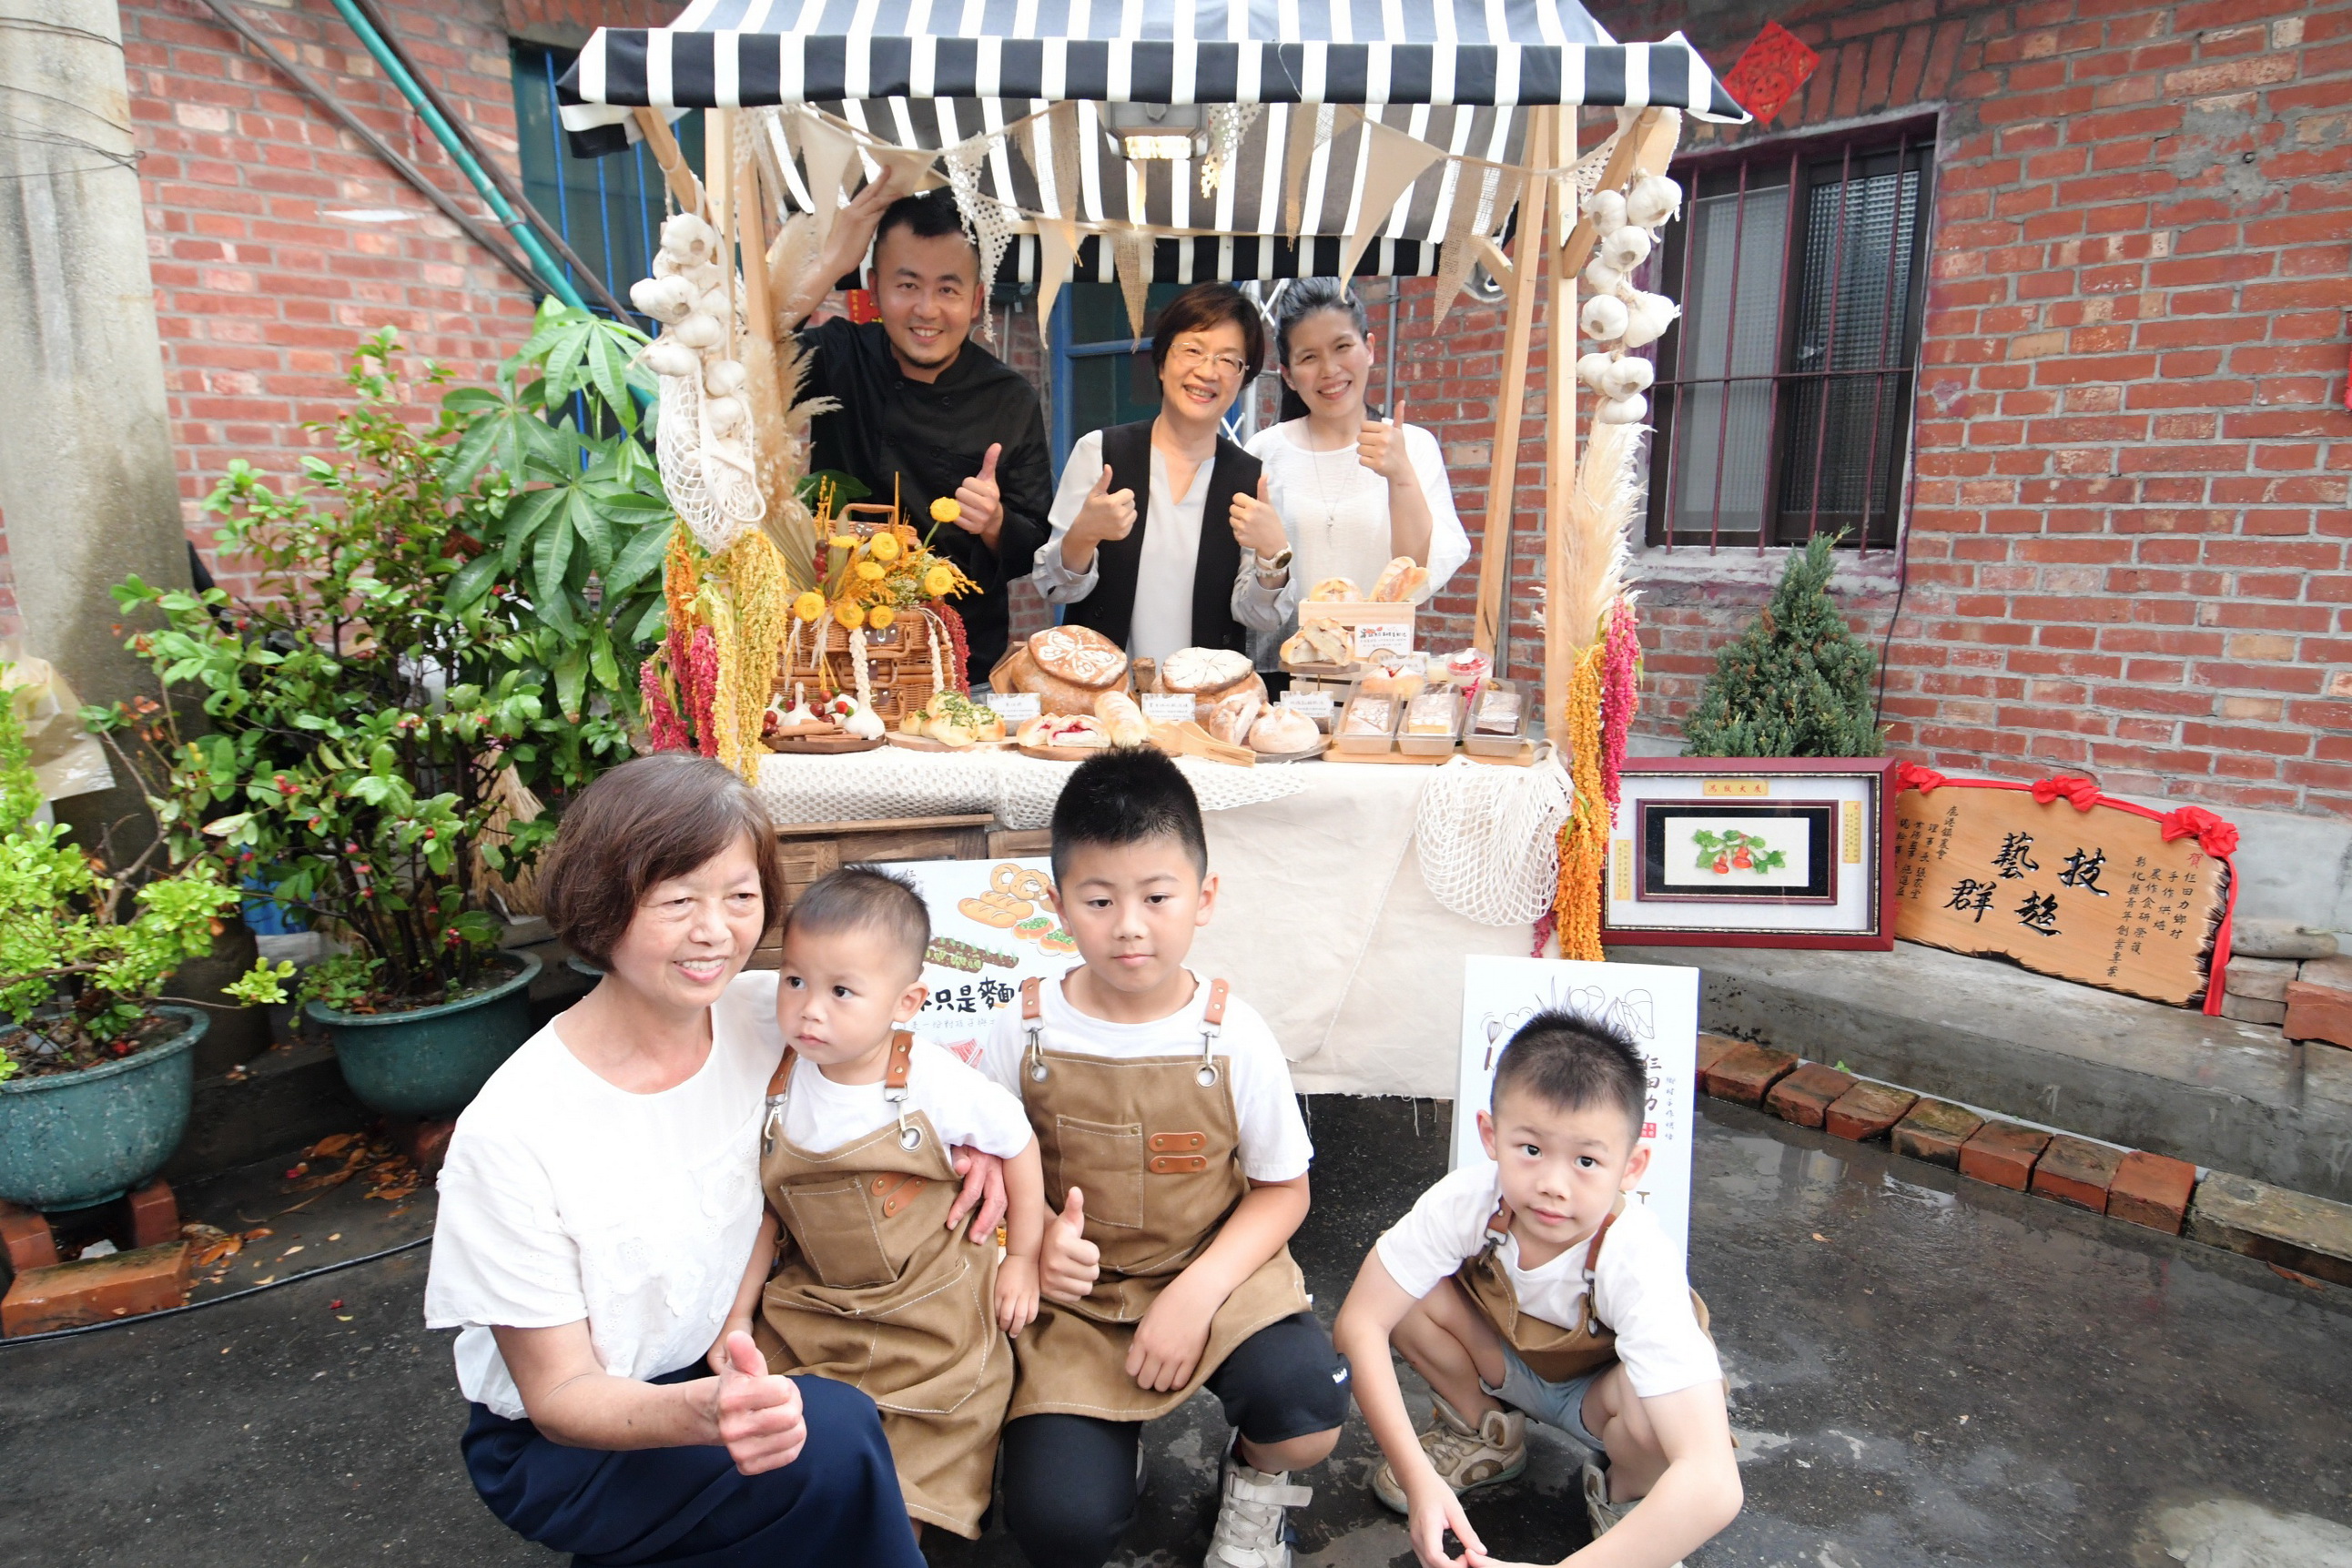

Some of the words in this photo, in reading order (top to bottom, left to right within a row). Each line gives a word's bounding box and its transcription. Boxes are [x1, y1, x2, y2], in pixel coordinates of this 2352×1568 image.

[2186, 852, 2204, 869] 賀
[2153, 870, 2179, 931] 手作烘焙
